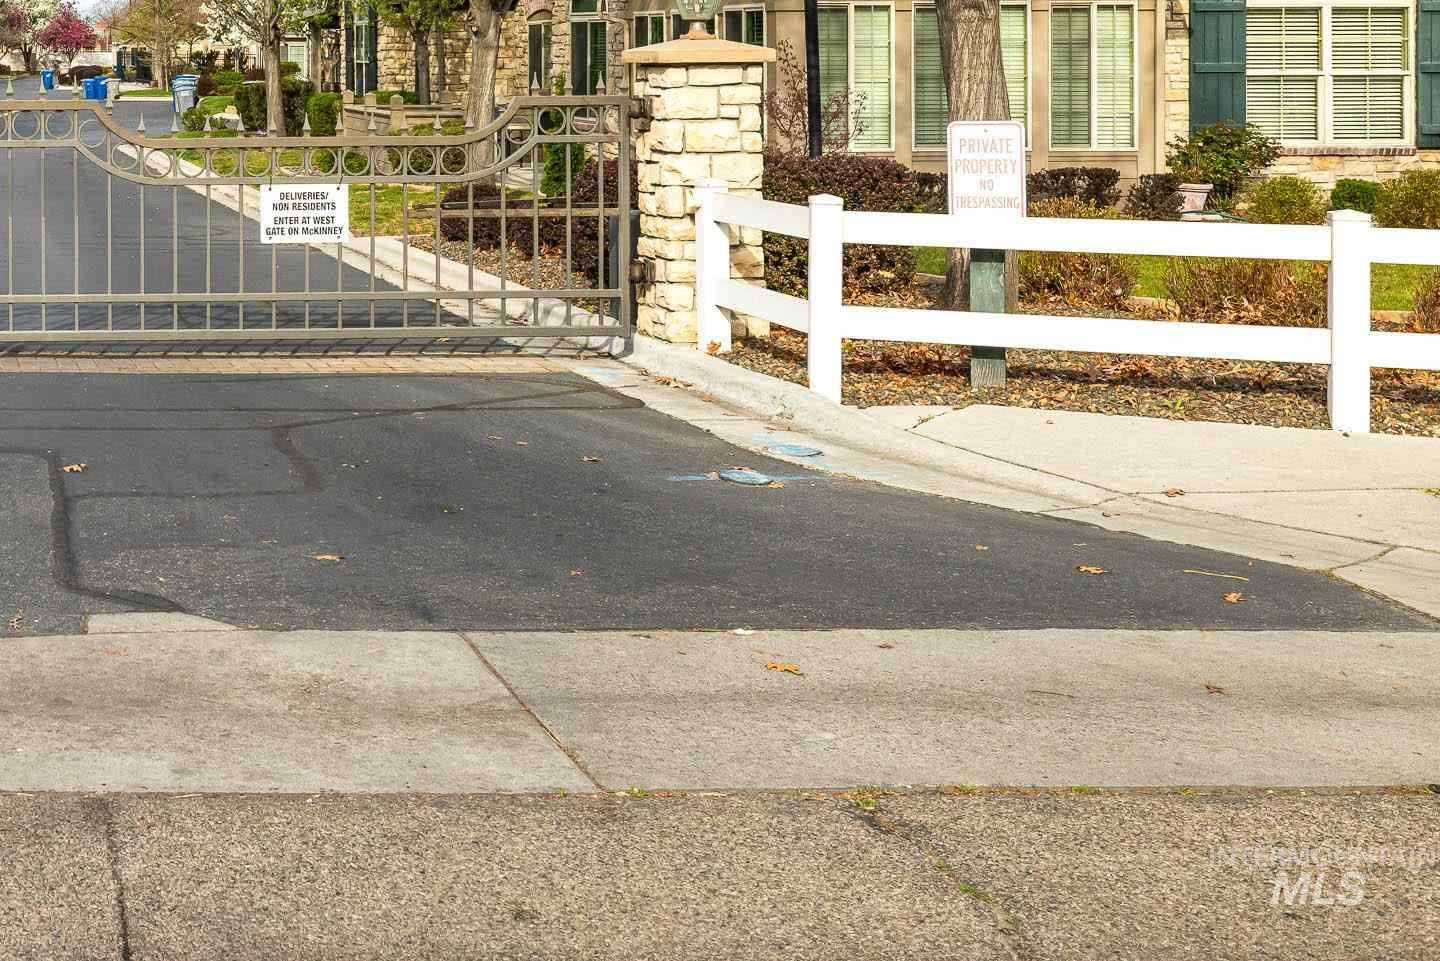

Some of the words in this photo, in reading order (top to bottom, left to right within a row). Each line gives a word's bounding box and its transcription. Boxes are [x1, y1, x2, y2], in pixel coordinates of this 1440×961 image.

[959, 138, 1013, 154] PRIVATE
[954, 158, 1017, 174] PROPERTY
[979, 178, 994, 191] NO
[279, 191, 329, 201] DELIVERIES/
[272, 202, 289, 211] NON
[291, 202, 336, 211] RESIDENTS
[955, 196, 1020, 209] TRESPASSING
[273, 216, 299, 225] ENTER
[301, 216, 310, 225] AT
[313, 216, 336, 225] WEST
[265, 227, 286, 236] GATE
[288, 227, 299, 235] ON
[301, 226, 344, 236] McKINNEY
